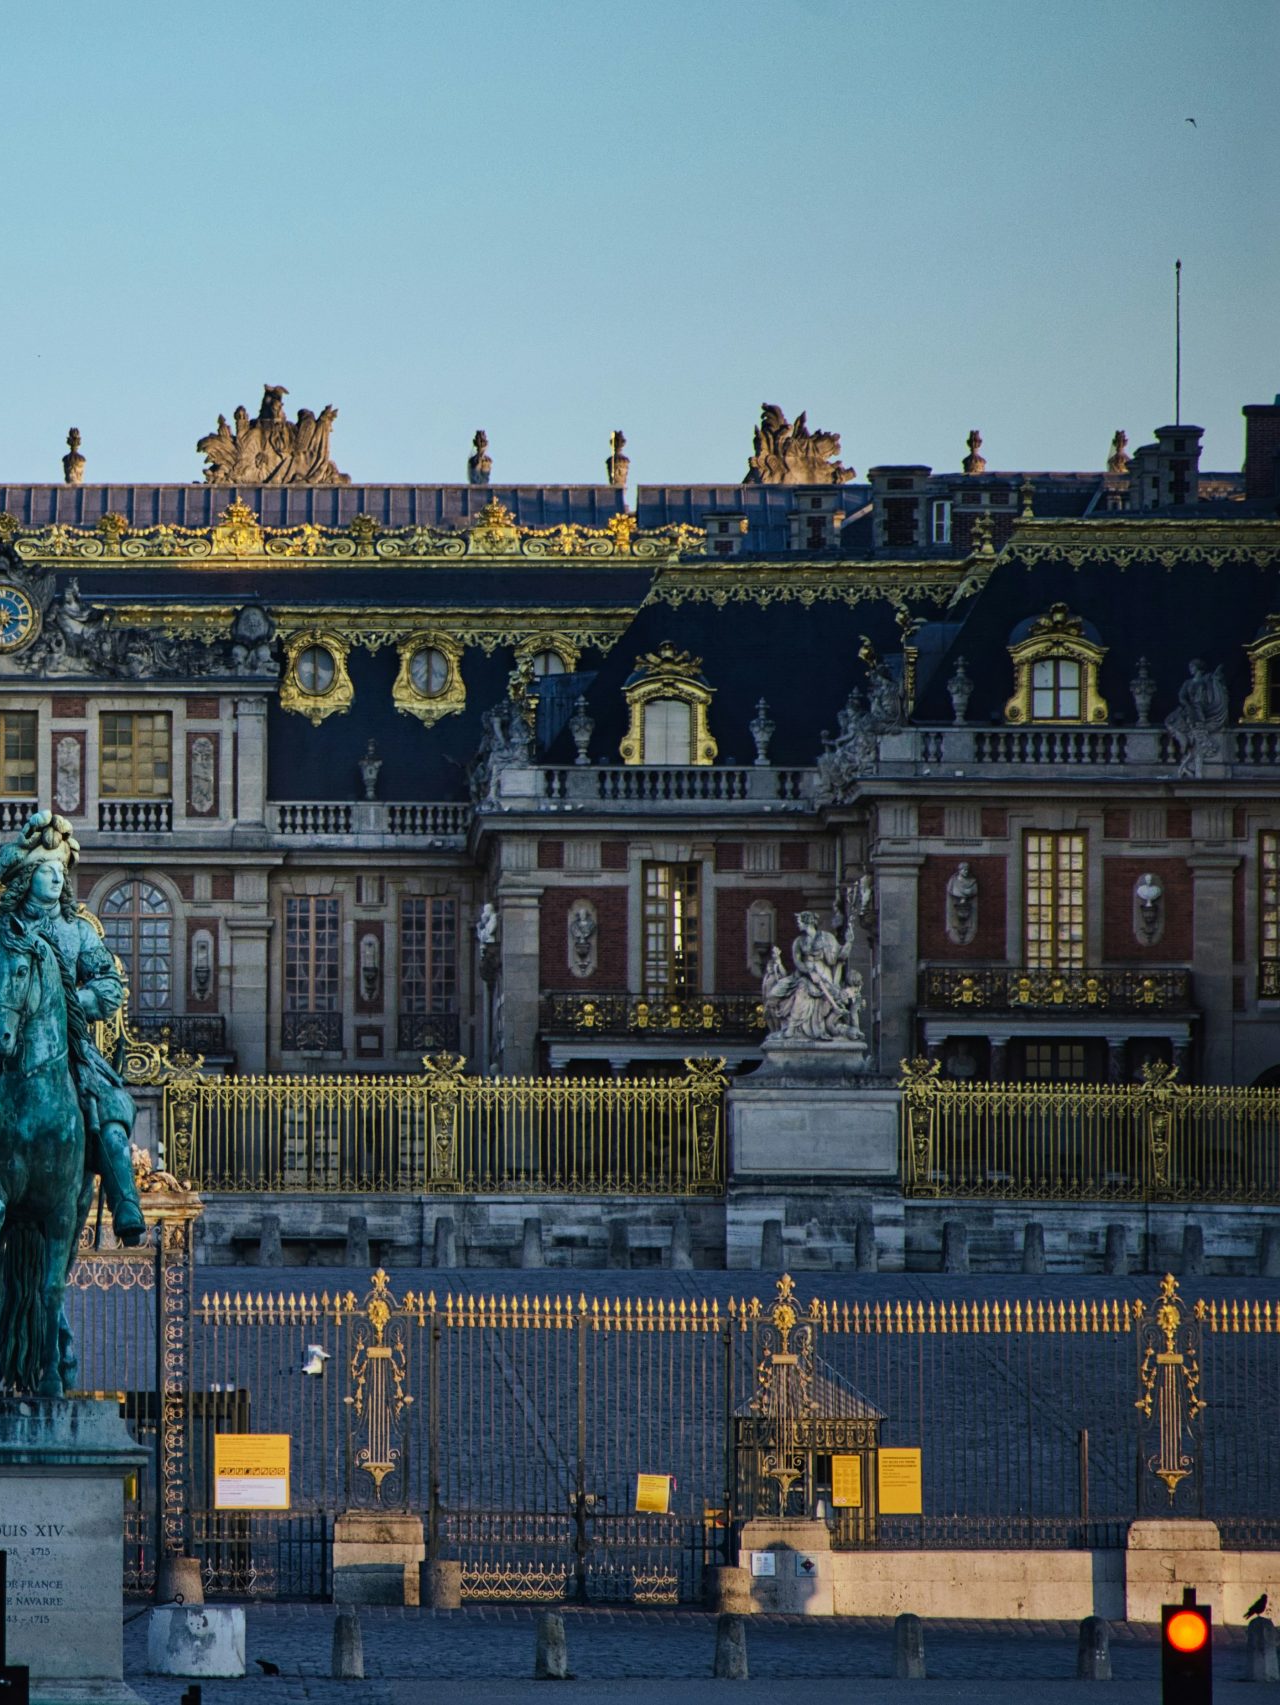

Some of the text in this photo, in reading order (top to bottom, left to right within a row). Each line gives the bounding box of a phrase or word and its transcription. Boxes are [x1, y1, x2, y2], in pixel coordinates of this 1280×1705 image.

[35, 1525, 64, 1537] XIV
[31, 1547, 51, 1556] 1715
[21, 1580, 63, 1589] FRANCE
[16, 1596, 64, 1606] NAVARRE
[30, 1615, 49, 1624] 1715
